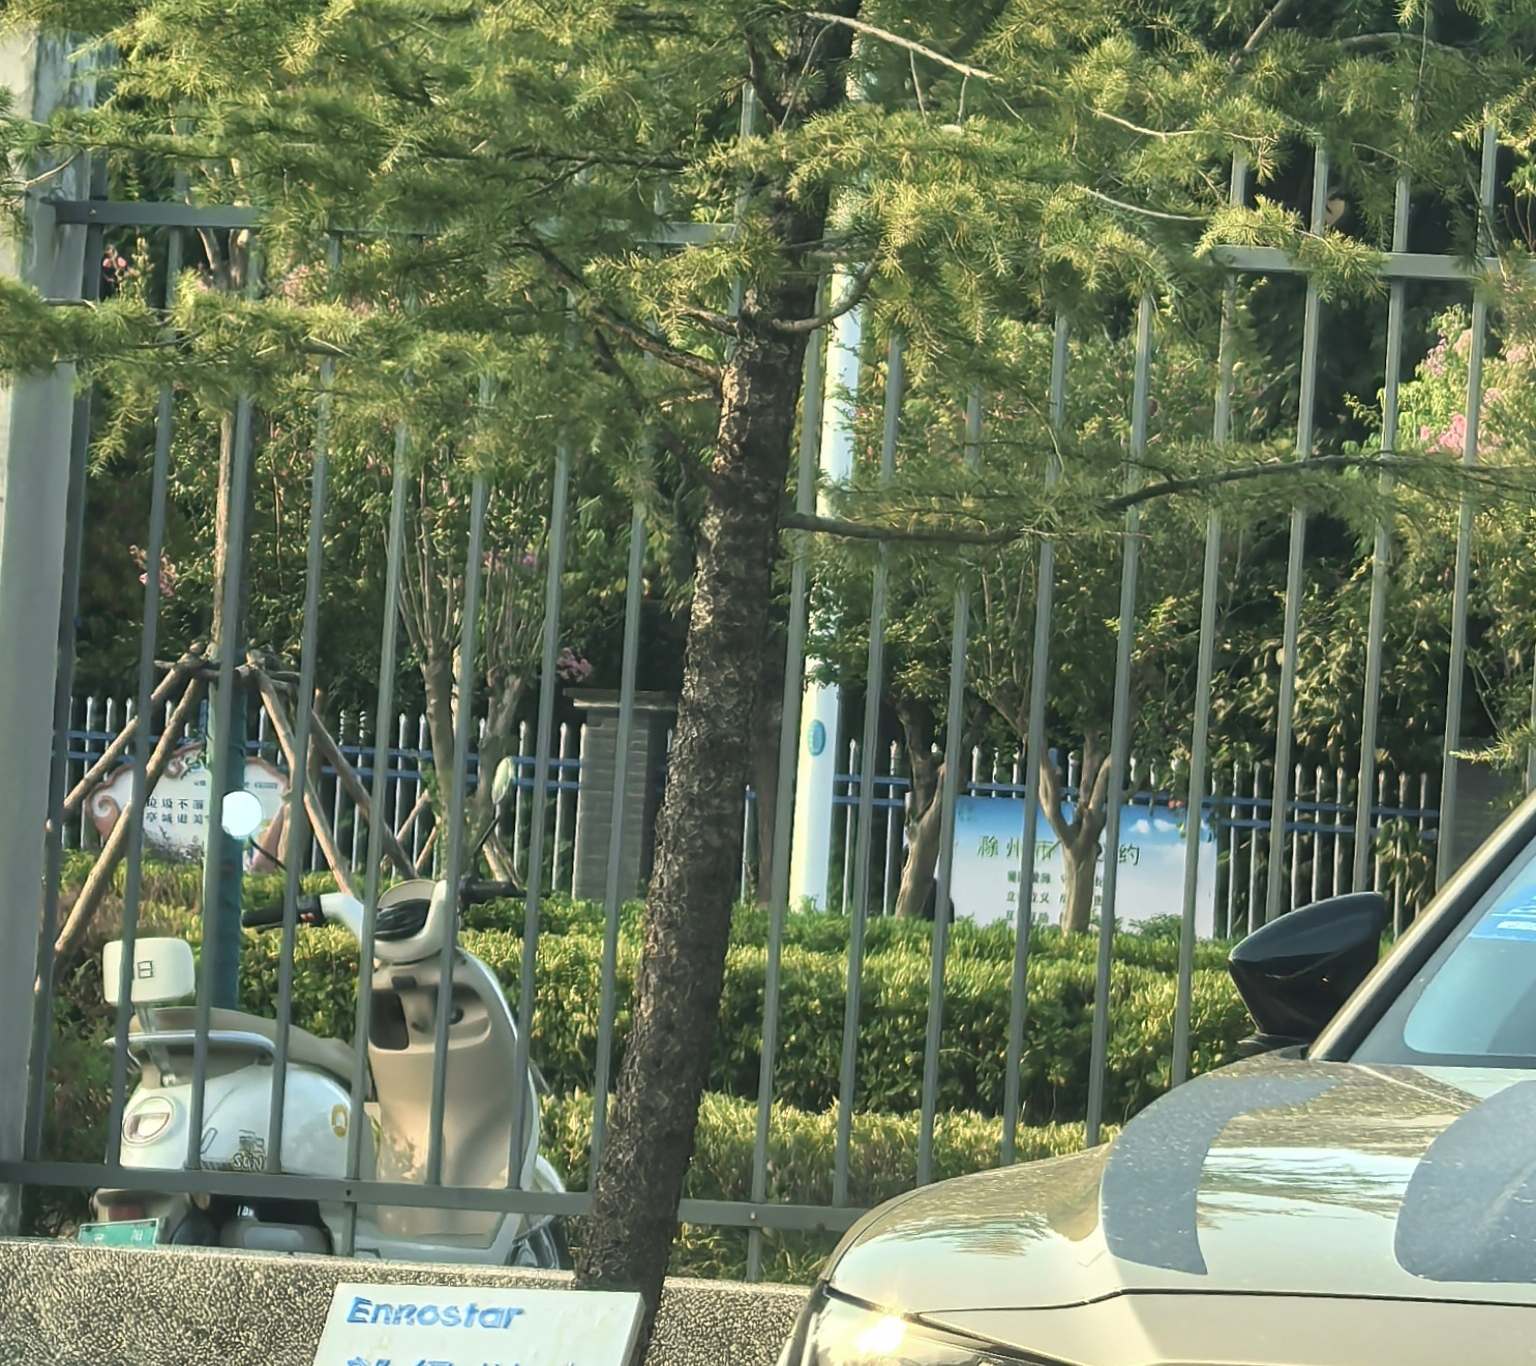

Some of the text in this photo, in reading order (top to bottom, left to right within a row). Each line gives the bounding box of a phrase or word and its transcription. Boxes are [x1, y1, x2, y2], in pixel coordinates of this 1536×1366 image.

[977, 835, 1140, 866] 滁州市约
[346, 1296, 526, 1329] Ennostar
